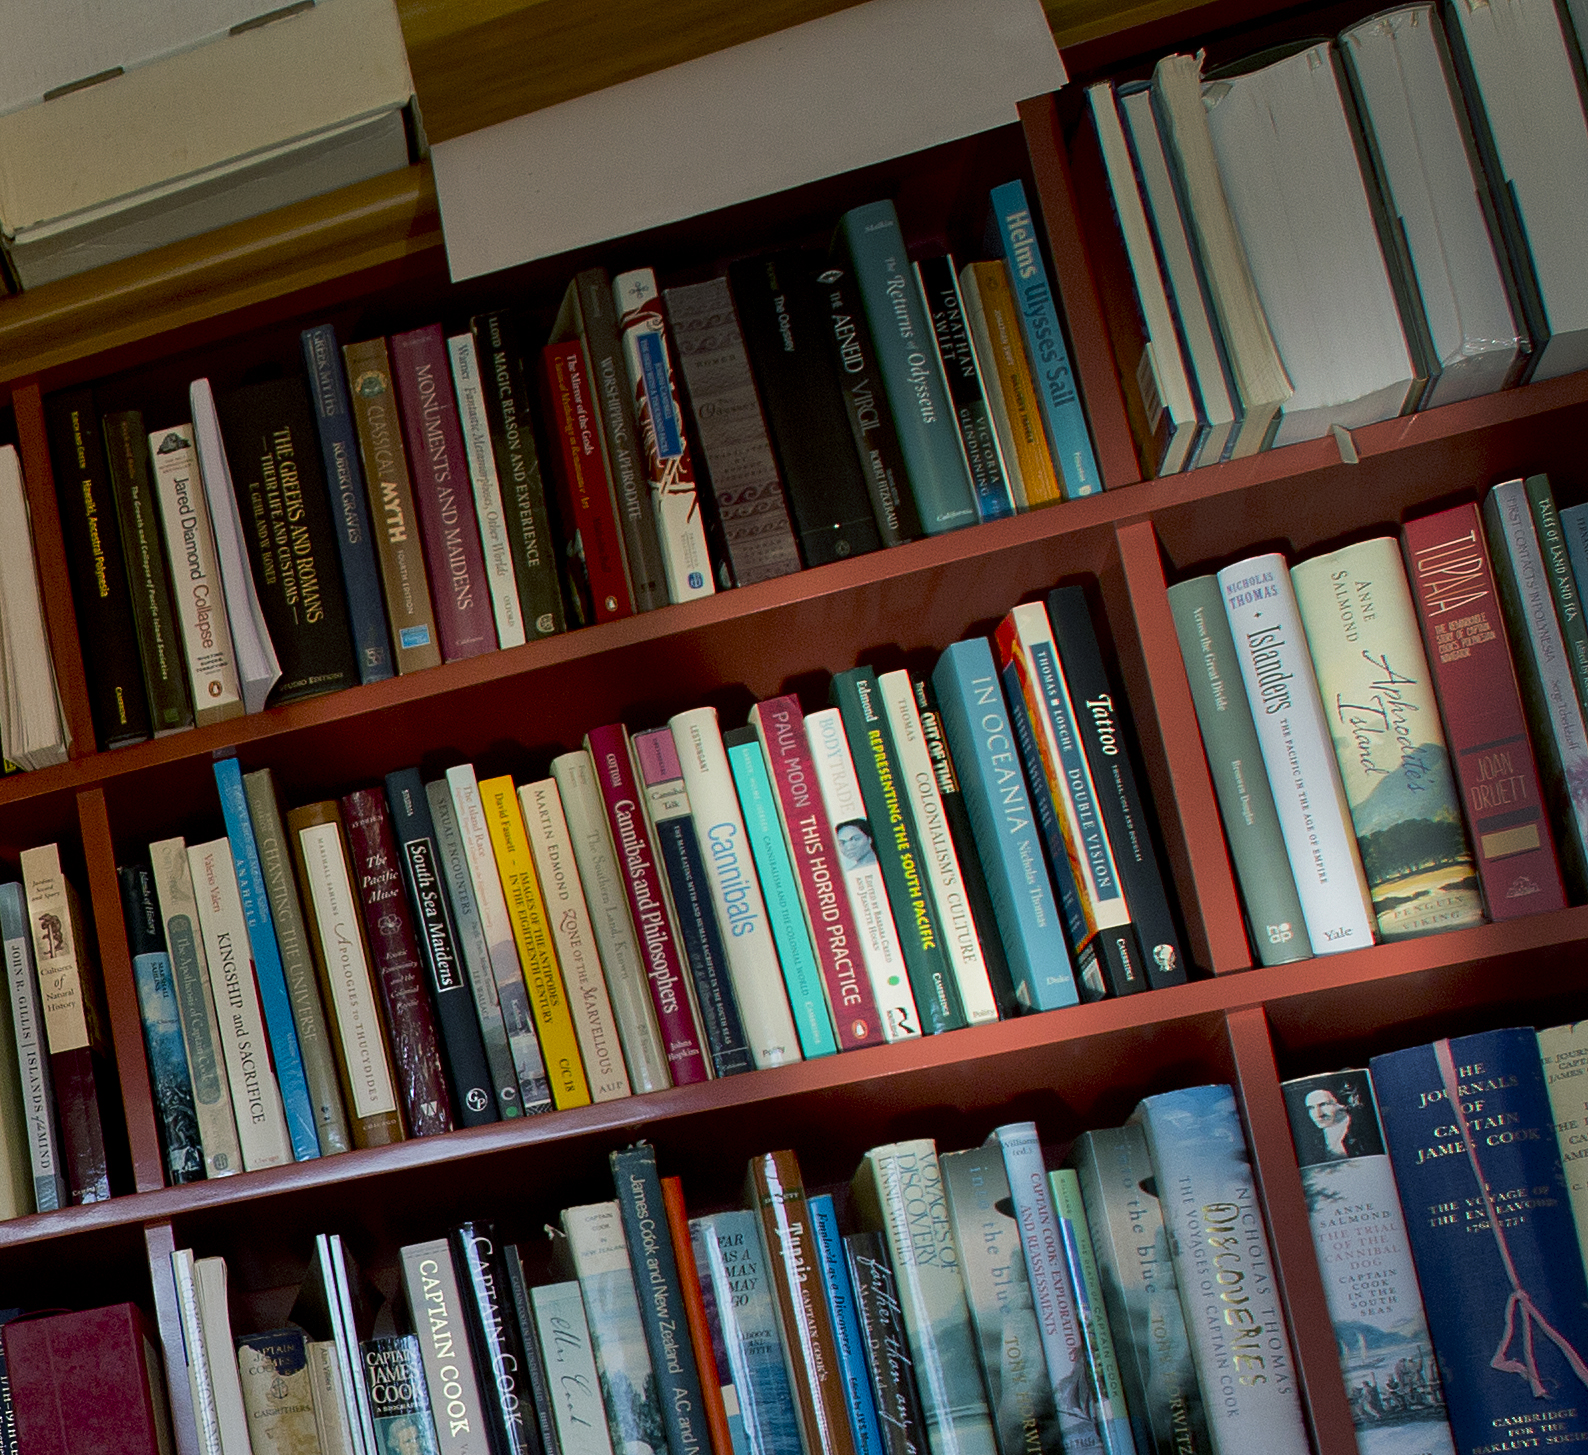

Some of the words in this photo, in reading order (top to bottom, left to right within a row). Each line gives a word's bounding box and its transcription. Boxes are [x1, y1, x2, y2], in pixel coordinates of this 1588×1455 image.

[1004, 210, 1038, 280] Helms
[1045, 367, 1075, 408] Sail
[272, 427, 293, 460] THE
[414, 363, 449, 483] MONUMENTS
[173, 477, 195, 515] Jared
[278, 461, 306, 522] GREEKS
[437, 487, 459, 527] AND
[181, 518, 205, 580] Diamond
[291, 524, 312, 556] AND
[444, 528, 474, 610] MAIDENS
[297, 557, 325, 623] ROMANS
[1415, 530, 1488, 617] TUPAIA
[191, 584, 216, 649] Collapse
[857, 680, 878, 722] Edmond
[972, 677, 998, 705] IN
[1246, 626, 1293, 715] Islanders
[772, 711, 795, 755] PAUL
[1086, 694, 1119, 756] Tattoo
[1336, 694, 1380, 776] Island
[783, 758, 810, 808] MOON
[869, 730, 907, 823] REPRESENTING
[980, 714, 1029, 834] OCEANIA
[614, 800, 653, 878] Cannibals
[800, 815, 822, 854] THIS
[894, 824, 908, 851] THE
[1069, 768, 1098, 830] DOUBLE
[1086, 833, 1112, 888] VISION
[410, 845, 431, 888] South
[636, 880, 658, 909] and
[707, 822, 757, 937] Cannibals
[810, 857, 838, 922] HORRID
[901, 853, 923, 898] SOUTH
[422, 891, 439, 917] Sea
[911, 900, 936, 951] PACIFIC
[1323, 928, 1354, 940] Yale
[216, 932, 243, 1009] KINGSHIP
[430, 922, 455, 986] Maidens
[640, 911, 680, 1014] Philosophers
[827, 925, 861, 1006] PRACTICE
[232, 1014, 248, 1037] and
[237, 1042, 267, 1124] SACRIFICE
[630, 1175, 652, 1218] James
[1178, 1176, 1193, 1205] THE
[638, 1220, 660, 1254] Cook
[1185, 1208, 1206, 1276] VOYAGES
[645, 1258, 666, 1283] and
[1201, 1280, 1215, 1299] OF
[1236, 1188, 1272, 1295] NICHOLAS
[1261, 1308, 1293, 1395] THOMAS
[651, 1286, 671, 1318] New
[419, 1259, 454, 1359] CAPTAIN
[439, 1366, 470, 1438] COOK
[469, 1236, 505, 1342] CAPTAIN
[490, 1353, 524, 1431] COOK
[659, 1320, 683, 1374] Zealand
[1204, 1305, 1226, 1370] CAPTAIN
[1220, 1375, 1239, 1418] COOK
[678, 1416, 696, 1444] and
